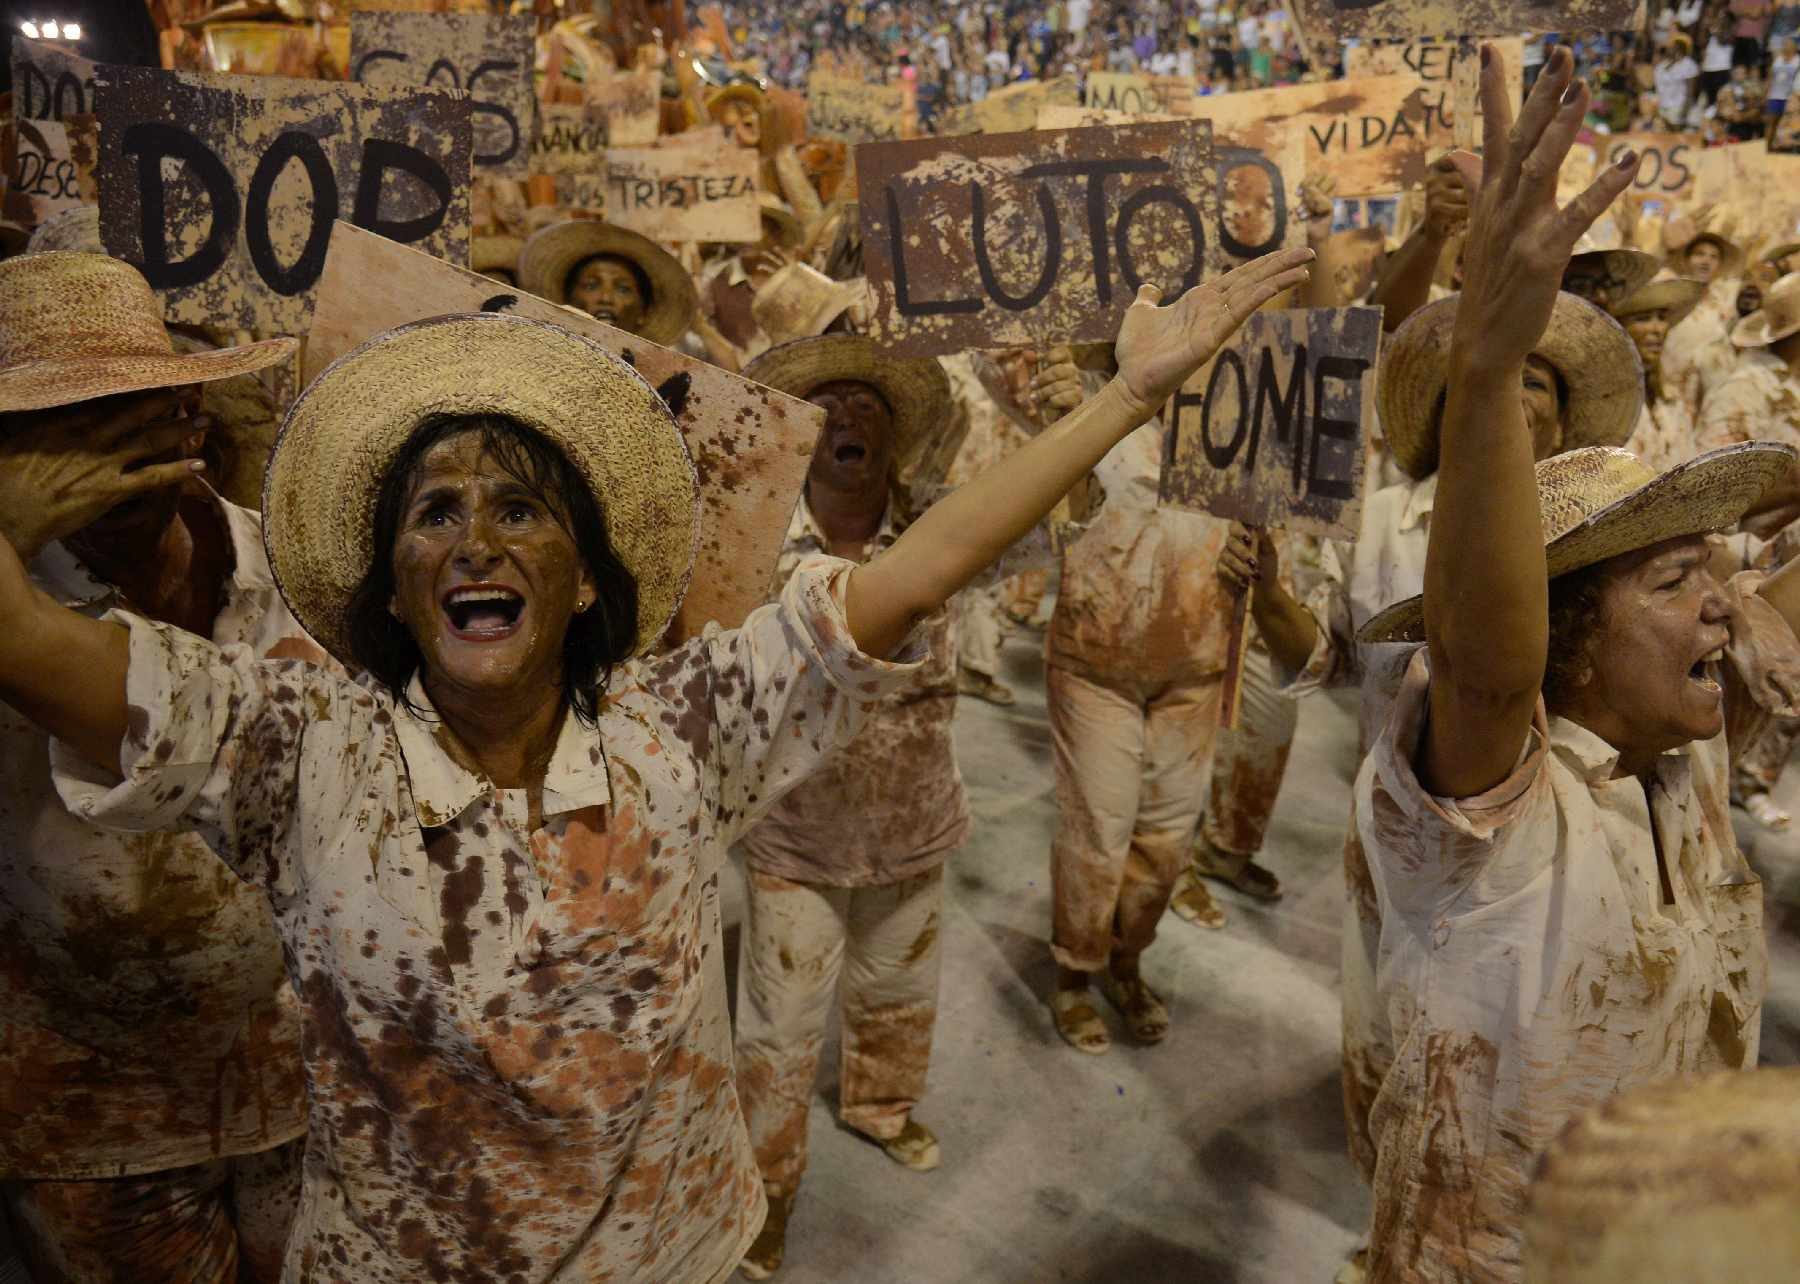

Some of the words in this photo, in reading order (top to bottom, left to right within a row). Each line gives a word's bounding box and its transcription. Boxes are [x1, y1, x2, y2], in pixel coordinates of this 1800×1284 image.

[15, 61, 97, 121] DO
[608, 174, 756, 209] TRISTEZA
[886, 157, 1206, 312] LUTO
